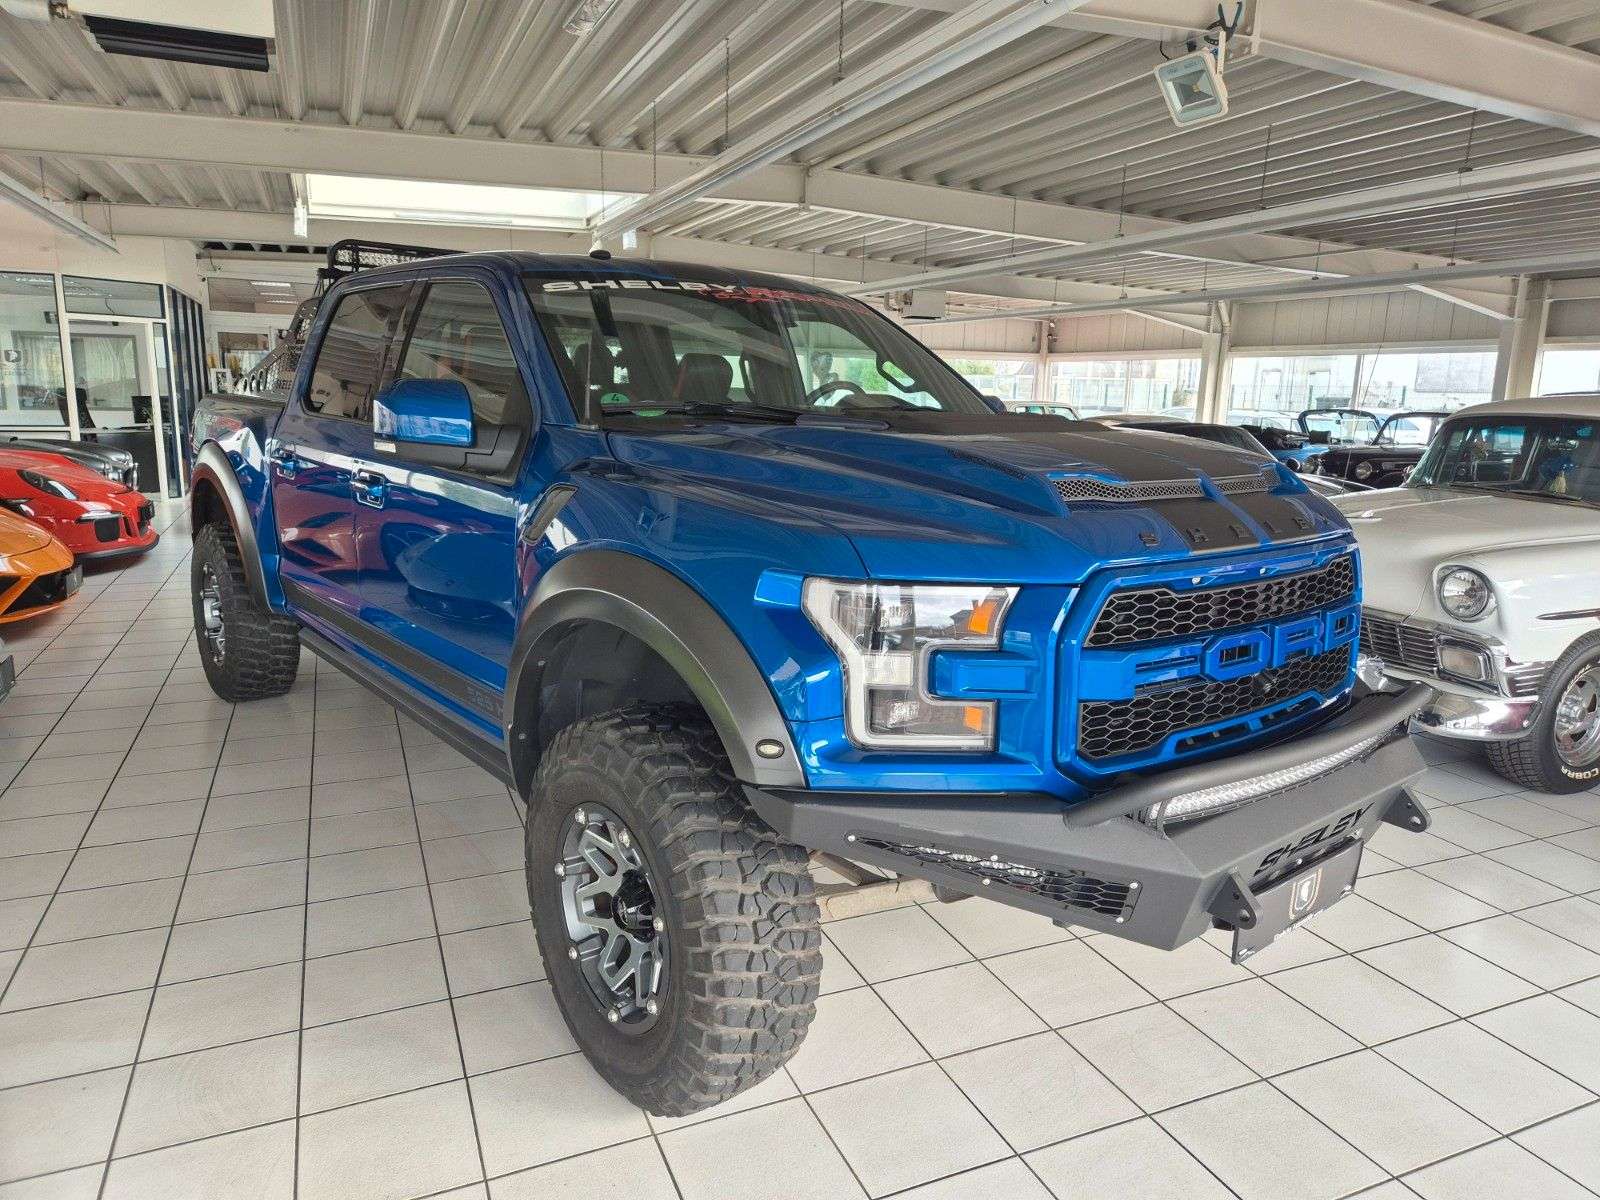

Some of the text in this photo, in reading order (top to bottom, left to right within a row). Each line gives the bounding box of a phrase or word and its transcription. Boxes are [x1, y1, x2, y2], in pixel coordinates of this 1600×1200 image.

[542, 280, 737, 293] SHELBY
[1079, 604, 1361, 700] FORD
[1561, 765, 1599, 780] COBRA
[1253, 801, 1376, 877] SHELBY
